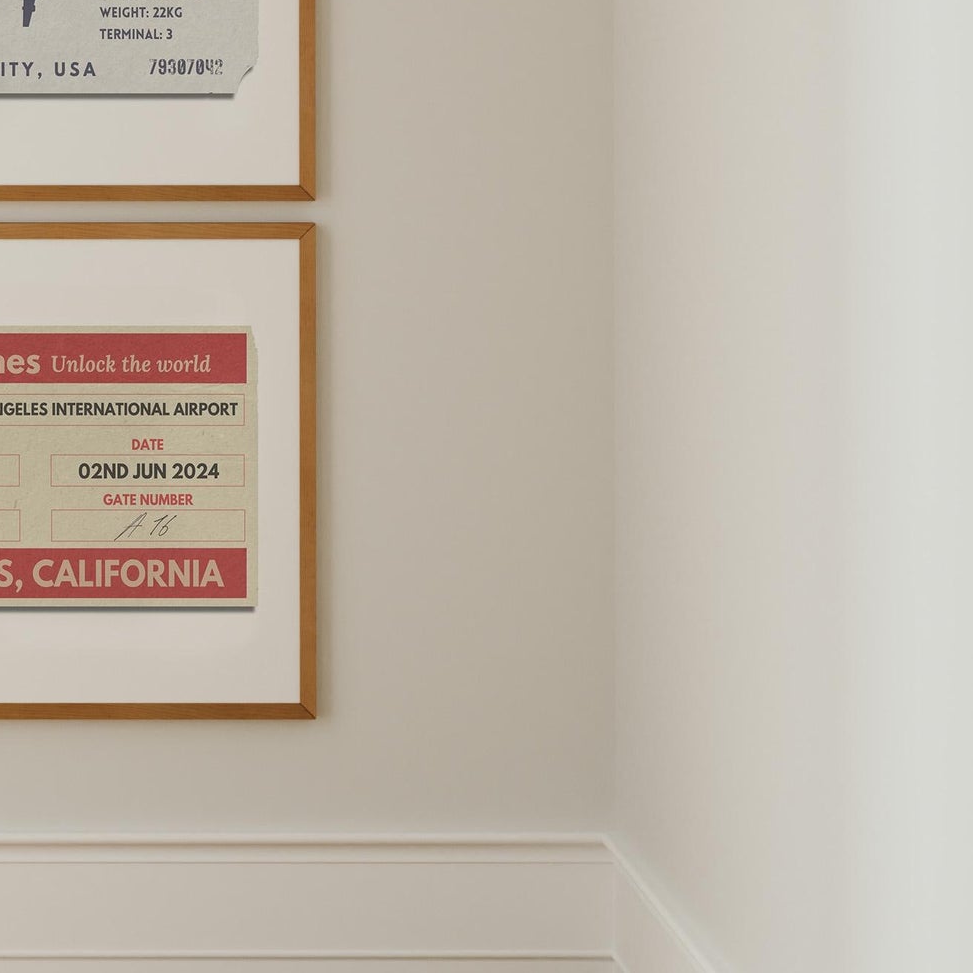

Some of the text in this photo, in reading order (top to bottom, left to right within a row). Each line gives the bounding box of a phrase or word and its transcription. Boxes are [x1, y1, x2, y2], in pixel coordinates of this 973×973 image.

[99, 7, 183, 18] WEIGHT: 22KG
[99, 29, 173, 39] TERMINAL: 3
[54, 61, 97, 77] USA
[51, 354, 212, 374] Unlock the world
[52, 402, 171, 416] INTERNATIONAL
[174, 402, 239, 416] AIRPORT
[131, 439, 164, 451] DATE
[78, 462, 219, 480] 02ND JUN 2024
[103, 494, 193, 506] GATE NUMBER
[114, 512, 147, 541] A
[32, 558, 225, 589] CALIFORNIA
